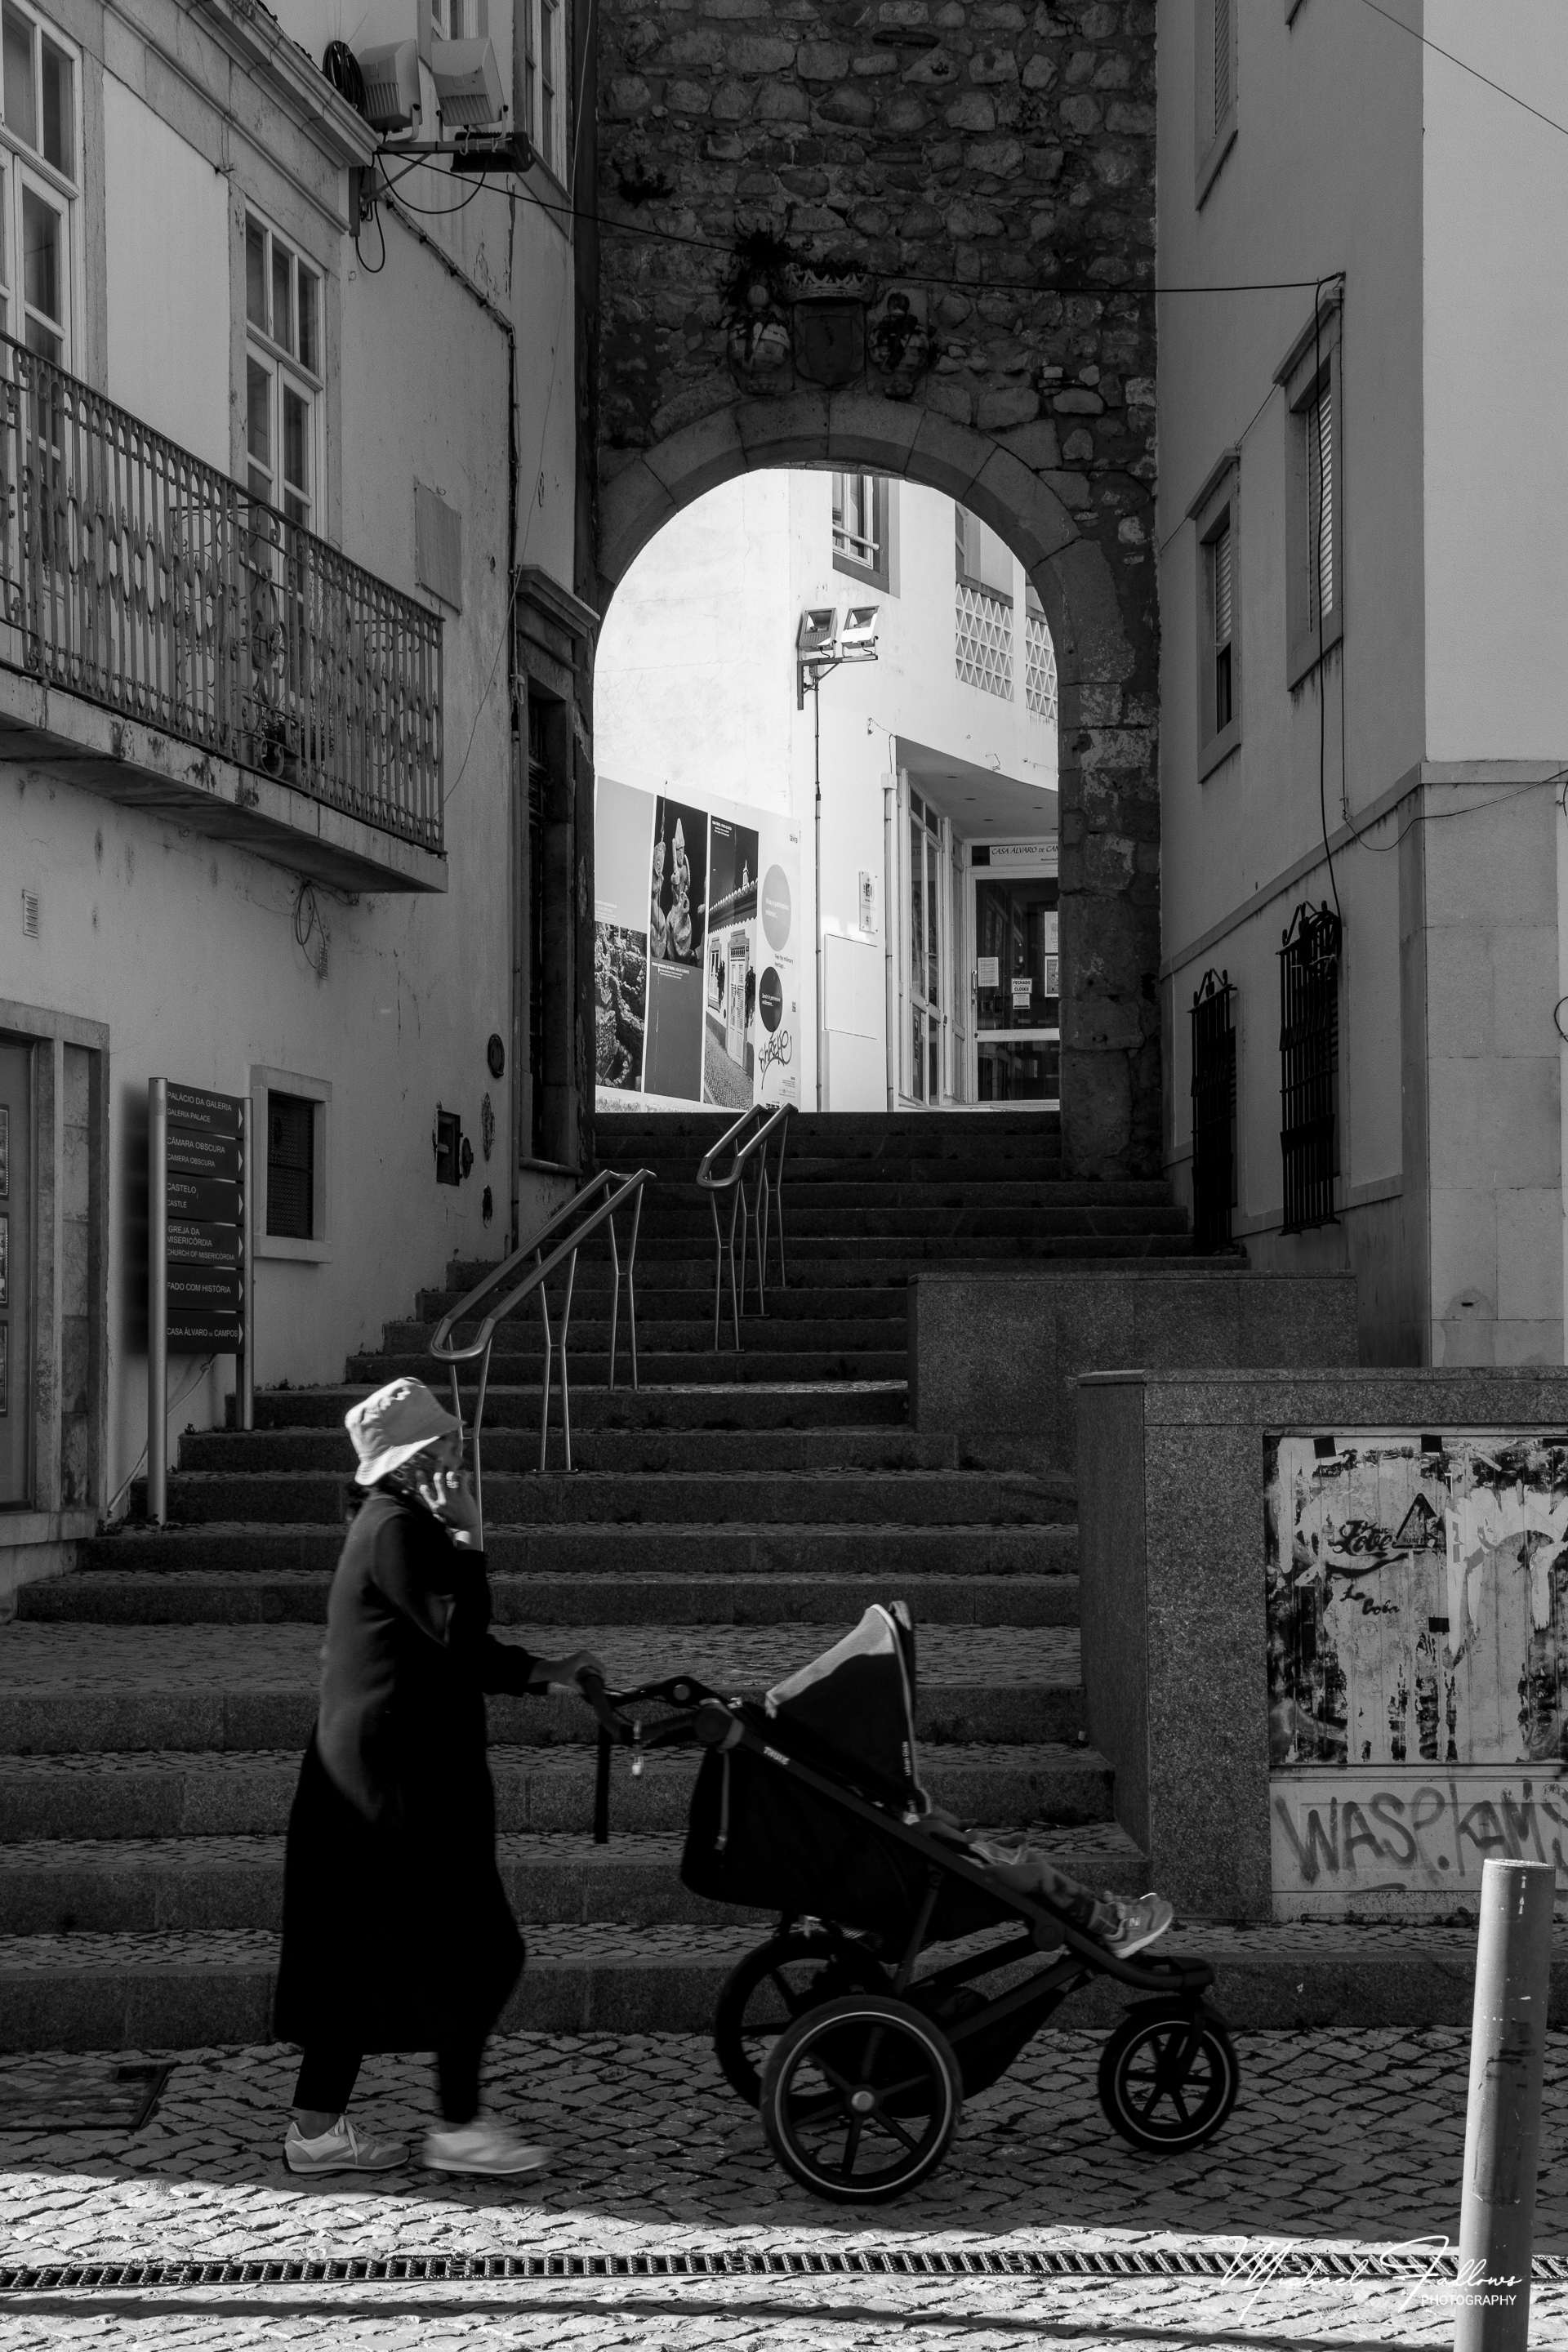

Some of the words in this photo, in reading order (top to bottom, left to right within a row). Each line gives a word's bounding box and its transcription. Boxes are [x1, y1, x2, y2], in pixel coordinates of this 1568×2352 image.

[167, 1091, 194, 1103] PALÁCIO
[195, 1097, 205, 1106] DA
[206, 1099, 233, 1111] GALERIA
[167, 1108, 189, 1118] GALERIA
[190, 1112, 211, 1123] PALACE
[167, 1136, 194, 1148] CÂMARA
[195, 1142, 226, 1154] OBSCURA
[167, 1153, 189, 1163] CAMERA
[189, 1156, 216, 1168] OBSCURA
[167, 1183, 197, 1194] CASTELO
[167, 1199, 188, 1209] CASTLE
[190, 1227, 200, 1236] DA
[167, 1248, 189, 1256] CHURCH
[198, 1251, 235, 1261] MISERICÓRDIA
[185, 1283, 201, 1291] COM
[202, 1285, 231, 1294] HISTÓRIA
[167, 1327, 183, 1335] CASA
[184, 1327, 208, 1336] ÁLVARO
[214, 1330, 238, 1338] CAMPOS
